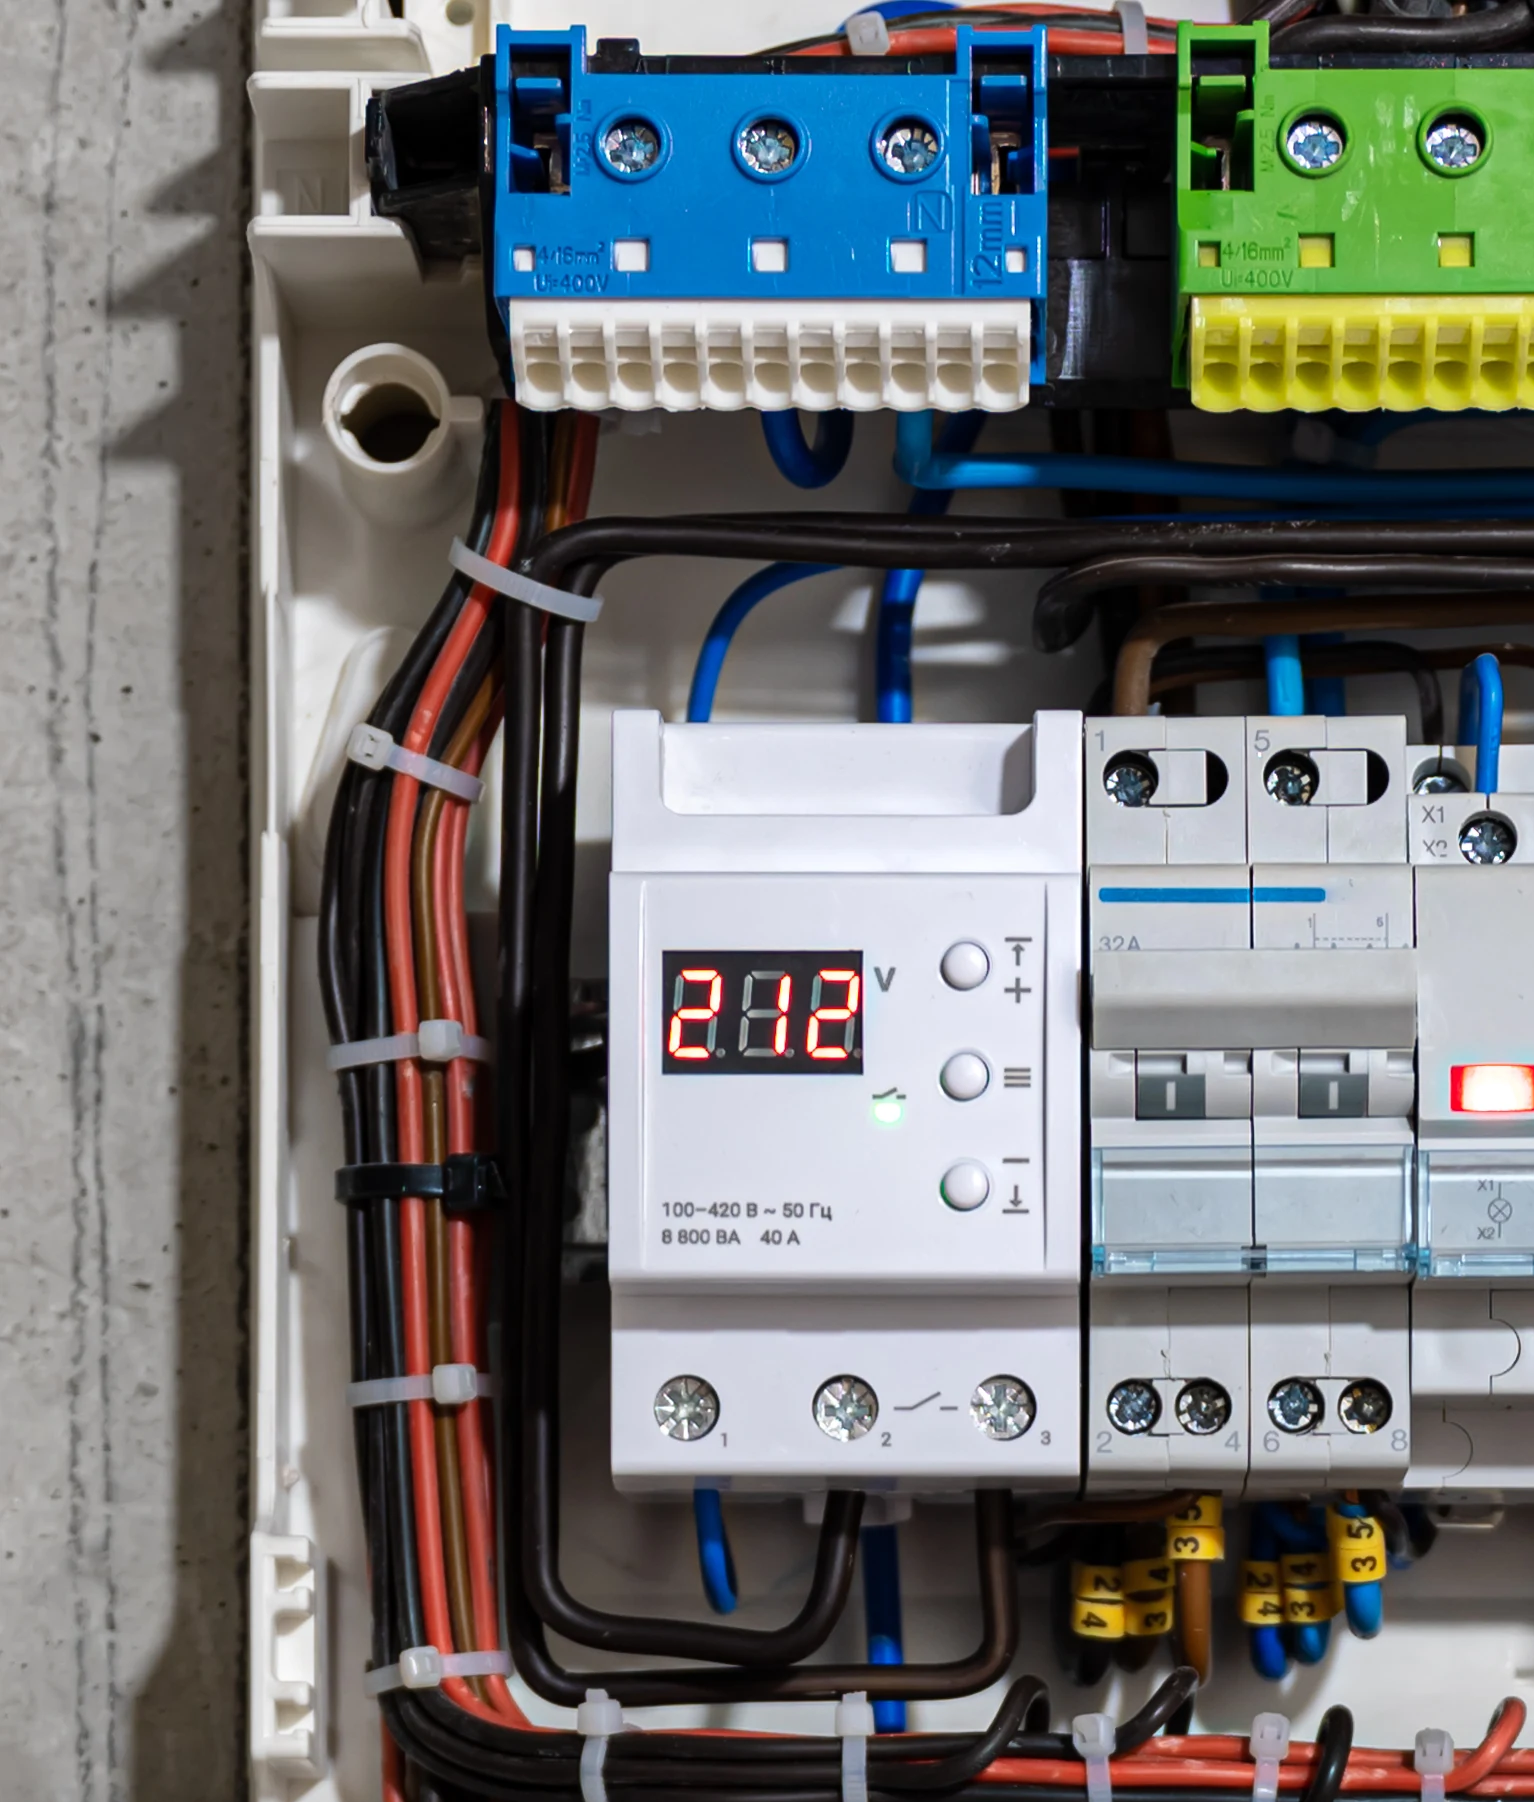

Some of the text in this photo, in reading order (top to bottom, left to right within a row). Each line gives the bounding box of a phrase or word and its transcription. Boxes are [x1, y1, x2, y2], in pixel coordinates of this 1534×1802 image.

[970, 201, 1003, 289] 12mm
[1094, 729, 1106, 752] 1
[1254, 729, 1271, 753] 5
[1421, 805, 1446, 824] X1
[1422, 839, 1448, 857] X2
[873, 967, 897, 993] V
[667, 968, 862, 1061] 212
[782, 1202, 805, 1219] 50
[809, 1202, 833, 1222] Гц
[760, 1229, 784, 1246] 40
[720, 1432, 729, 1448] 1
[881, 1432, 892, 1448] 2
[1040, 1430, 1052, 1446] 3
[1096, 1431, 1113, 1453] 2
[1224, 1430, 1242, 1452] 4
[1263, 1431, 1280, 1453] 6
[1390, 1429, 1408, 1451] 8
